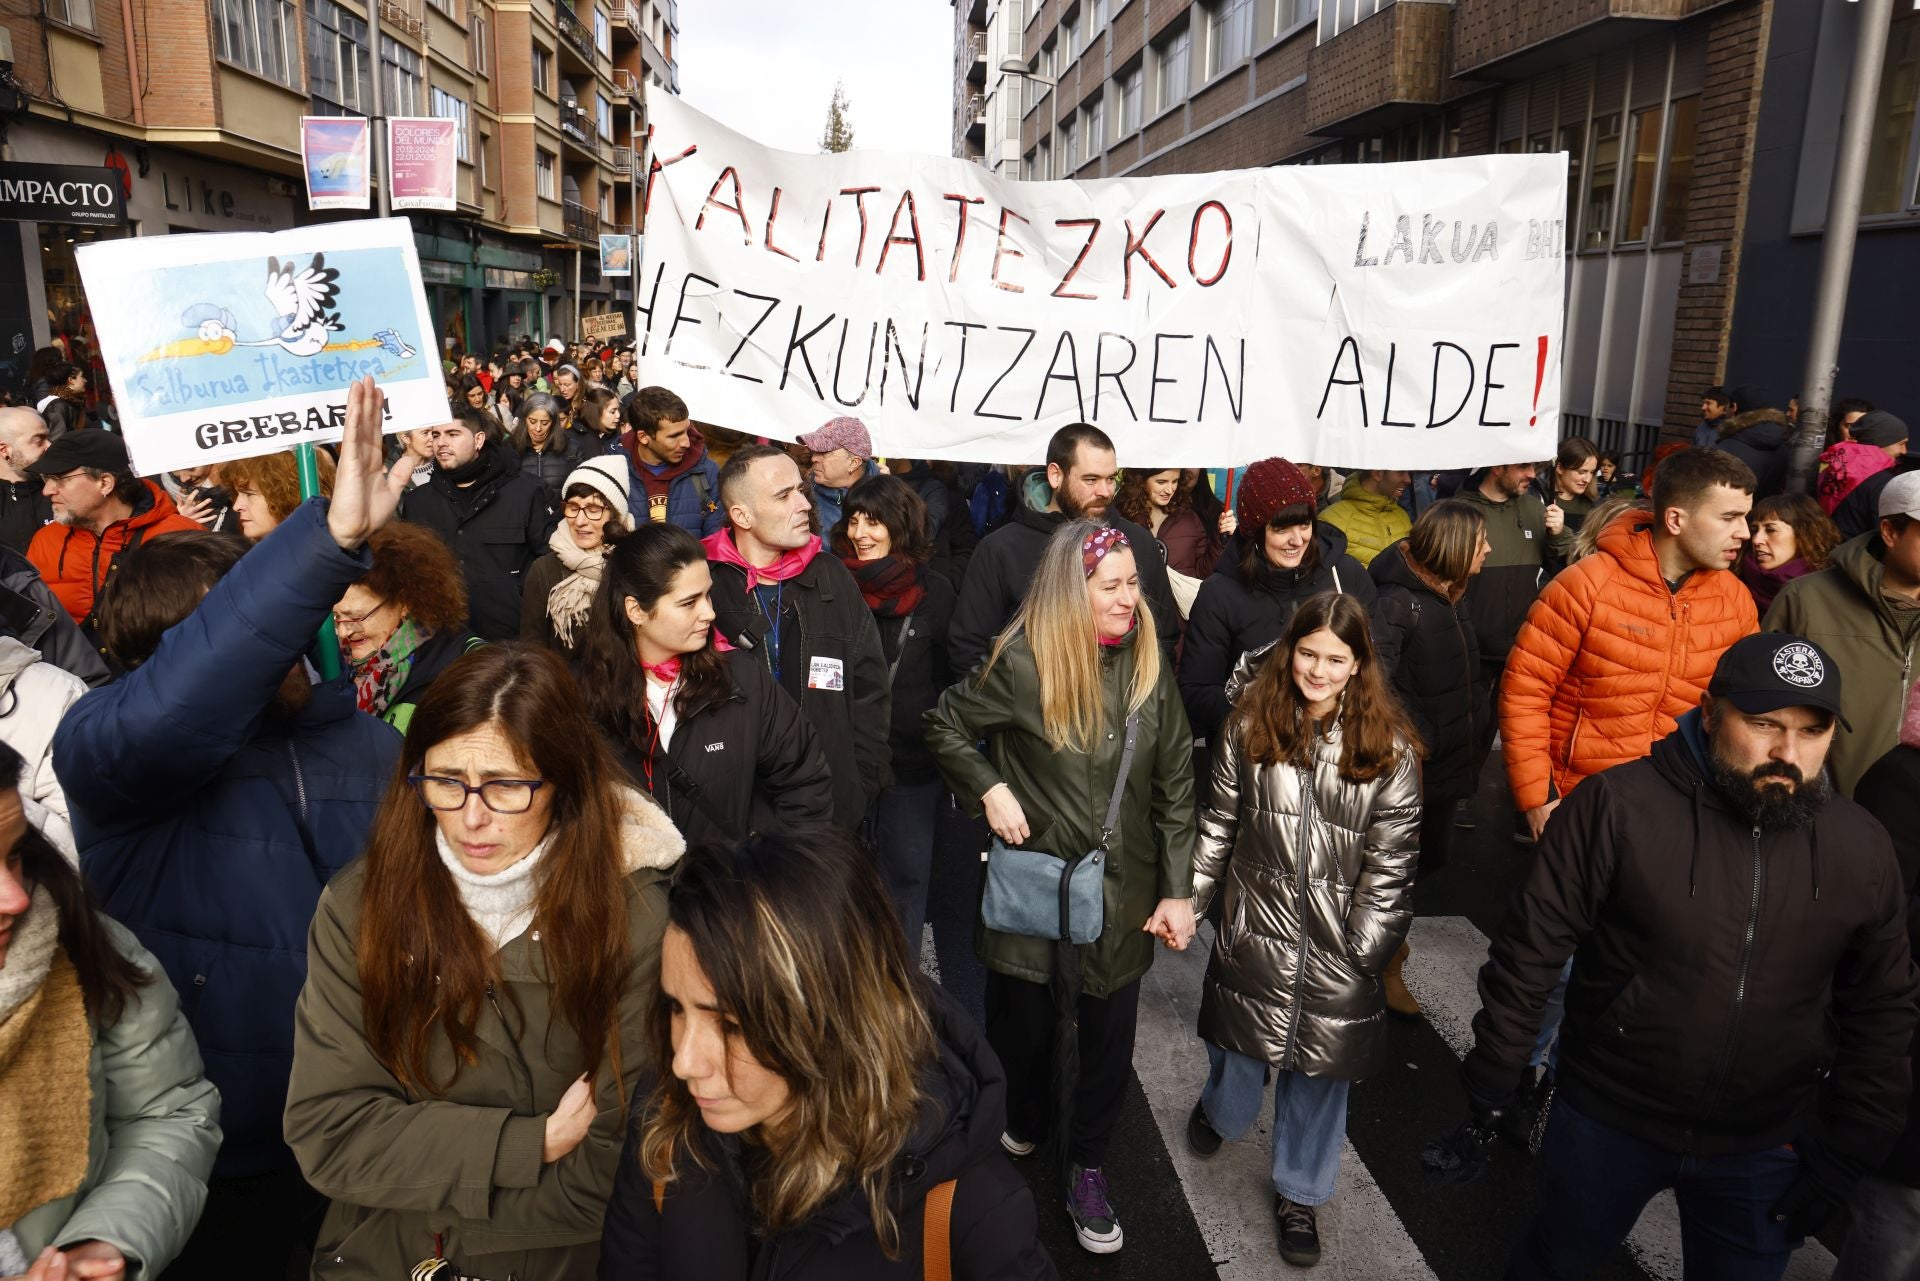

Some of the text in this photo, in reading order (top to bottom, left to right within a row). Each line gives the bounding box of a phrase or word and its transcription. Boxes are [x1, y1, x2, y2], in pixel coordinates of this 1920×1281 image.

[395, 128, 440, 137] COLORES
[395, 136, 413, 145] DEL
[162, 171, 235, 218] Like
[398, 199, 445, 208] CaixaForum
[1354, 210, 1499, 267] LAKUA
[254, 352, 385, 393] Ikastetxea
[1316, 335, 1549, 429] ALDE!
[195, 397, 393, 450] GREBAR!
[1787, 674, 1815, 684] JAPAN
[704, 741, 724, 753] VANS
